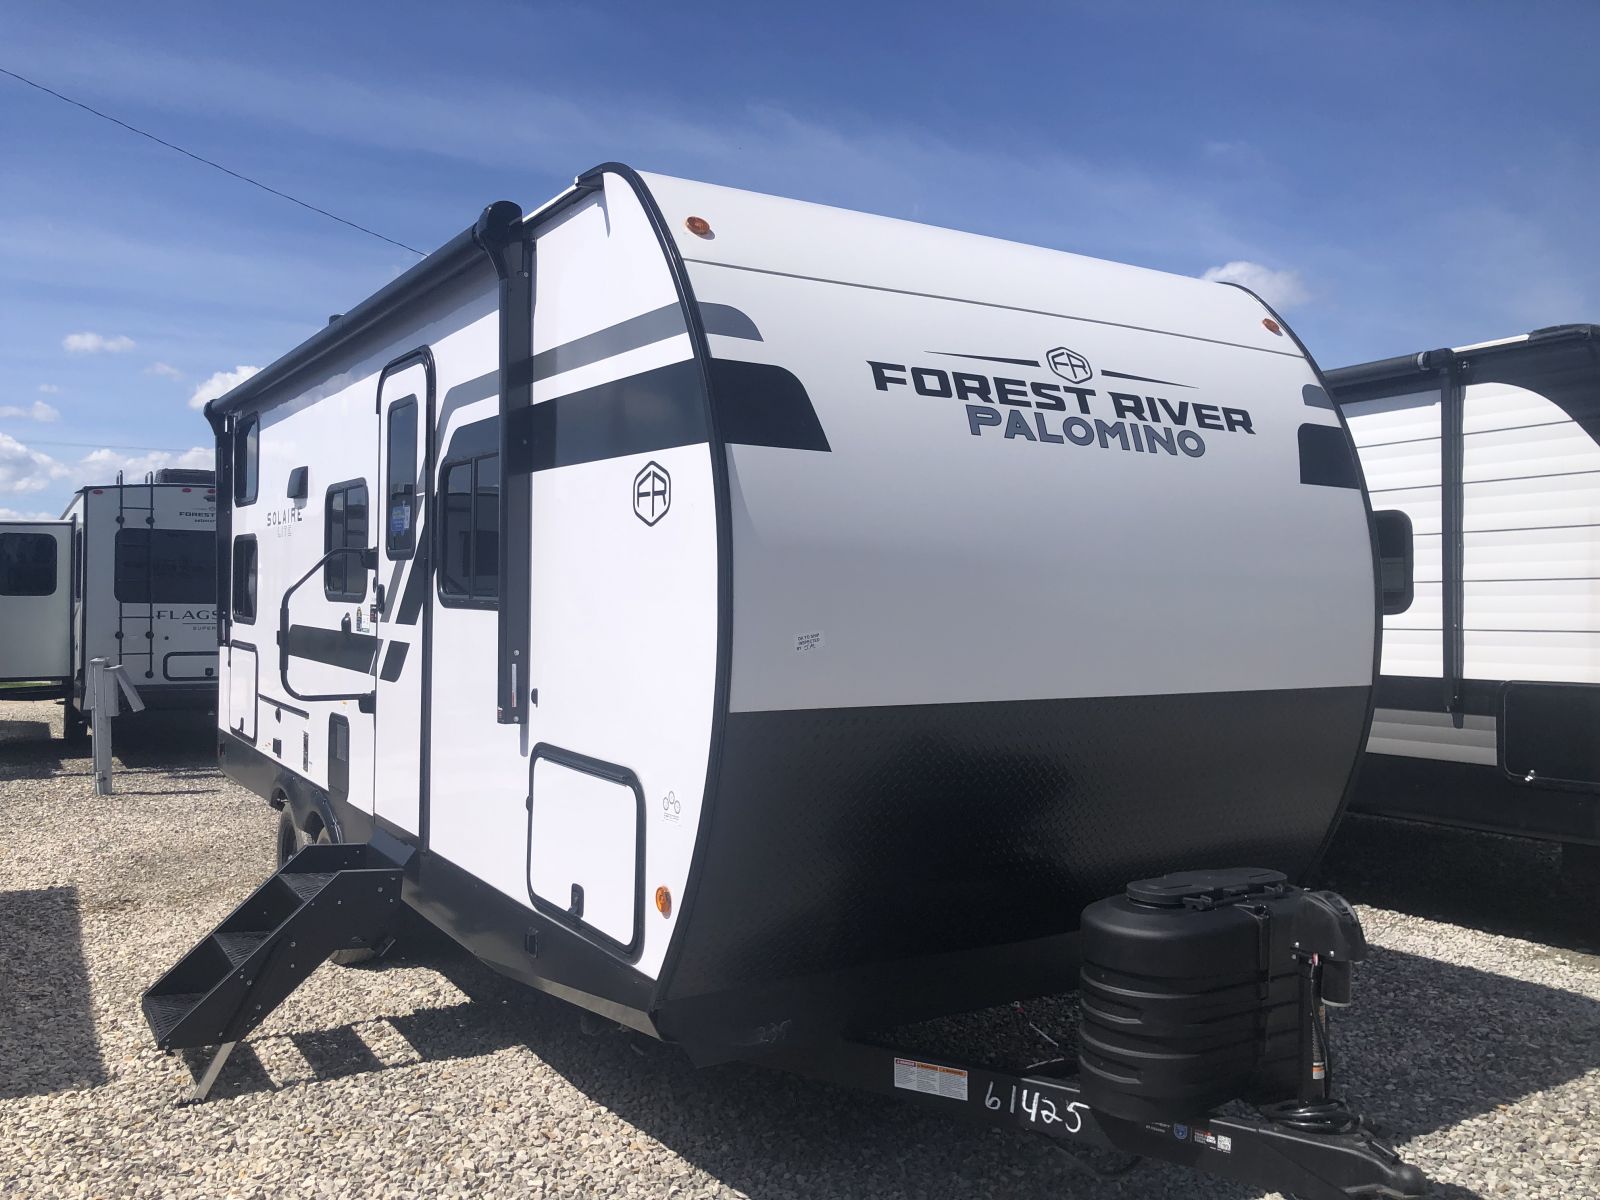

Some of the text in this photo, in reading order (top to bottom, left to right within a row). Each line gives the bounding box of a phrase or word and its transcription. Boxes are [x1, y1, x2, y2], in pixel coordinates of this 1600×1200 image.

[866, 360, 1256, 435] FOREST RIVER
[966, 404, 1206, 458] PALOMINO
[267, 508, 302, 526] SOLAIRE
[985, 1081, 1090, 1133] 61425
